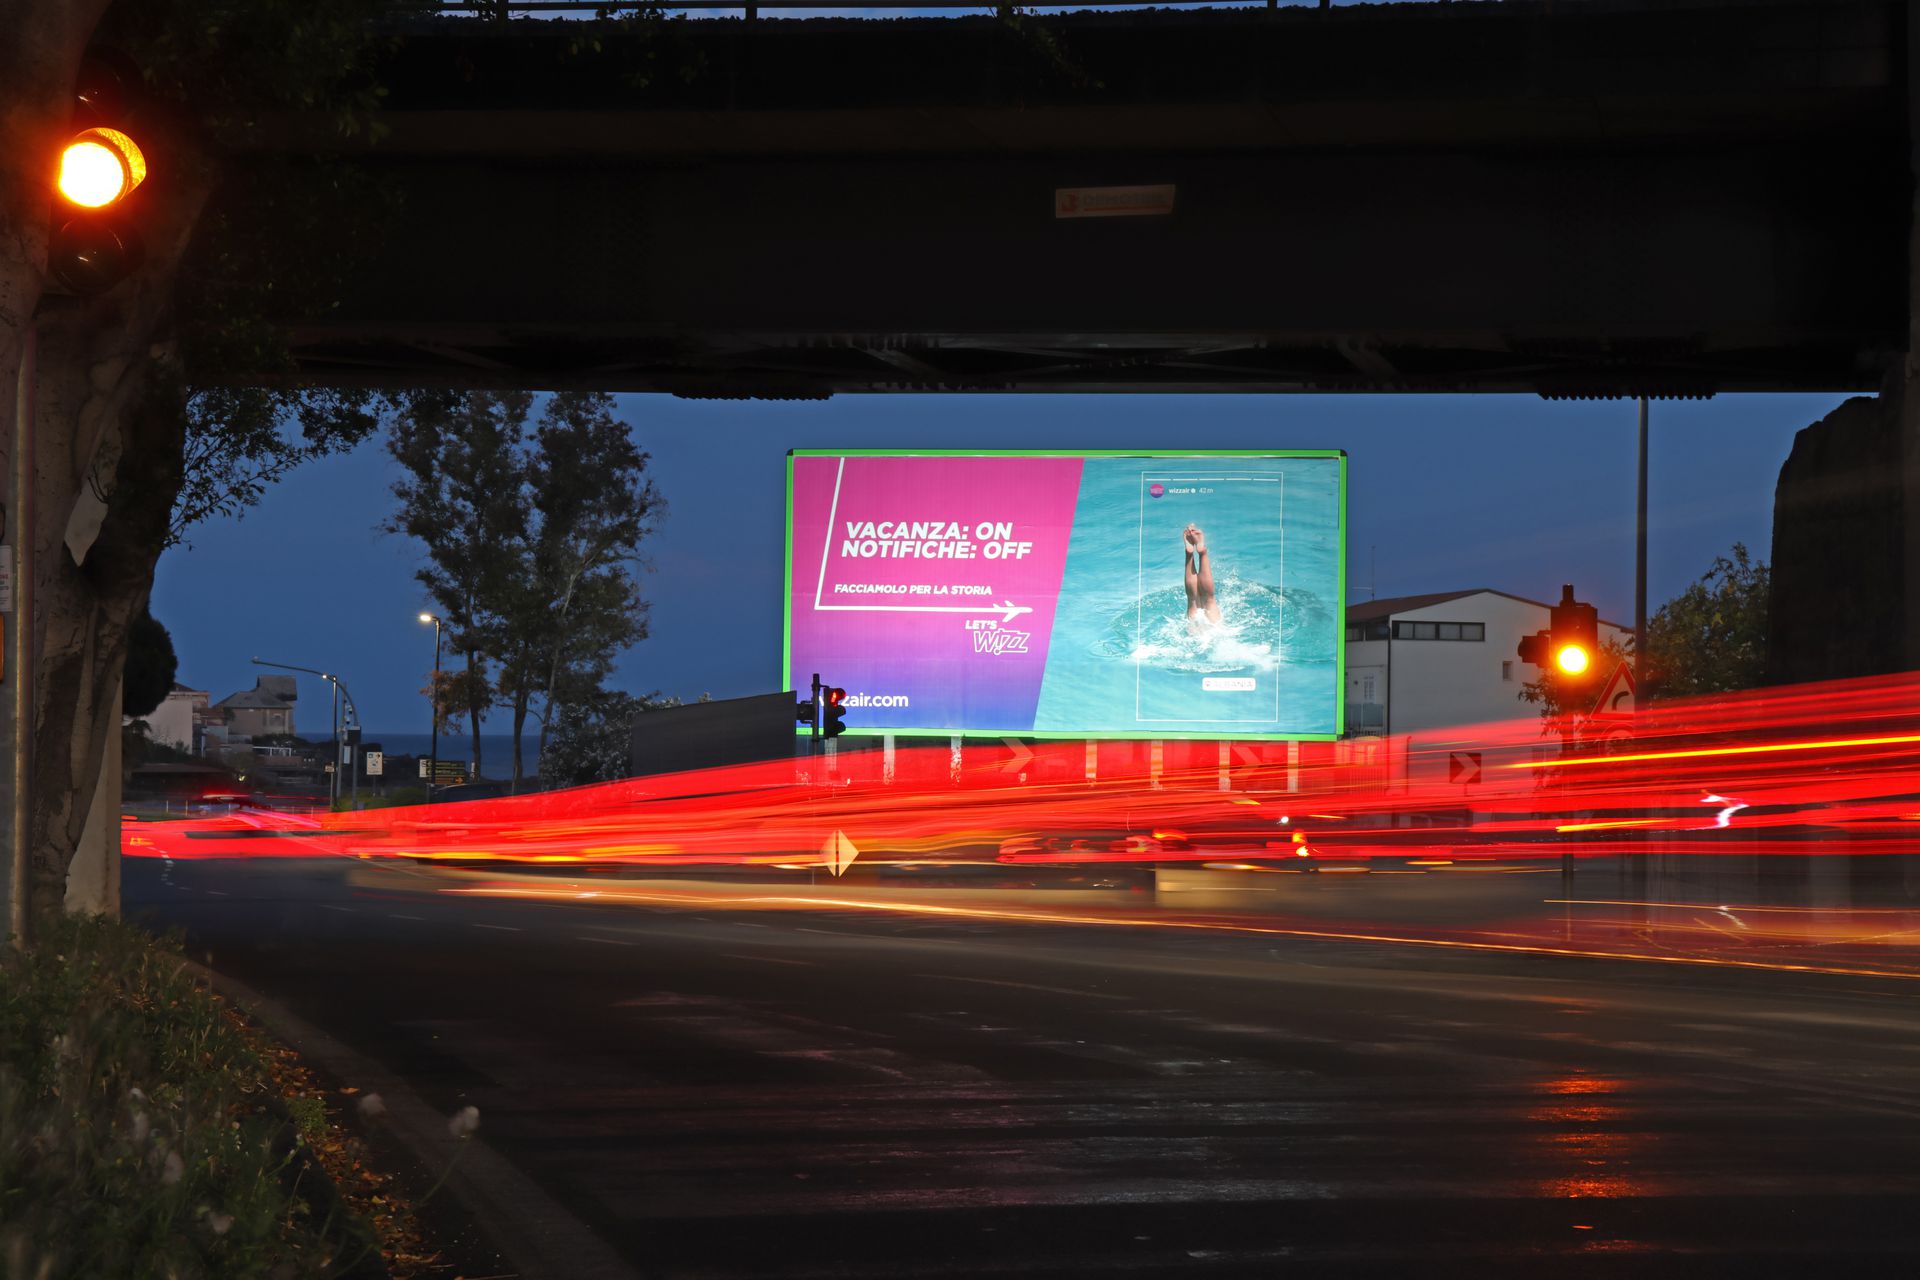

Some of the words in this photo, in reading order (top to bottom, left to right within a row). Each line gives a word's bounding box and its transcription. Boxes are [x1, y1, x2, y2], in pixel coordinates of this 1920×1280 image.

[846, 522, 969, 540] VACANZA:
[975, 522, 1013, 540] ON
[841, 540, 977, 559] NOTIFICHE:
[983, 541, 1032, 560] OFF
[834, 584, 907, 595] FACCIAMOLO
[909, 585, 932, 596] PER
[933, 585, 948, 596] LA
[950, 585, 993, 596] STORIA
[965, 620, 998, 630] LET'S
[819, 692, 909, 707] zair.com
